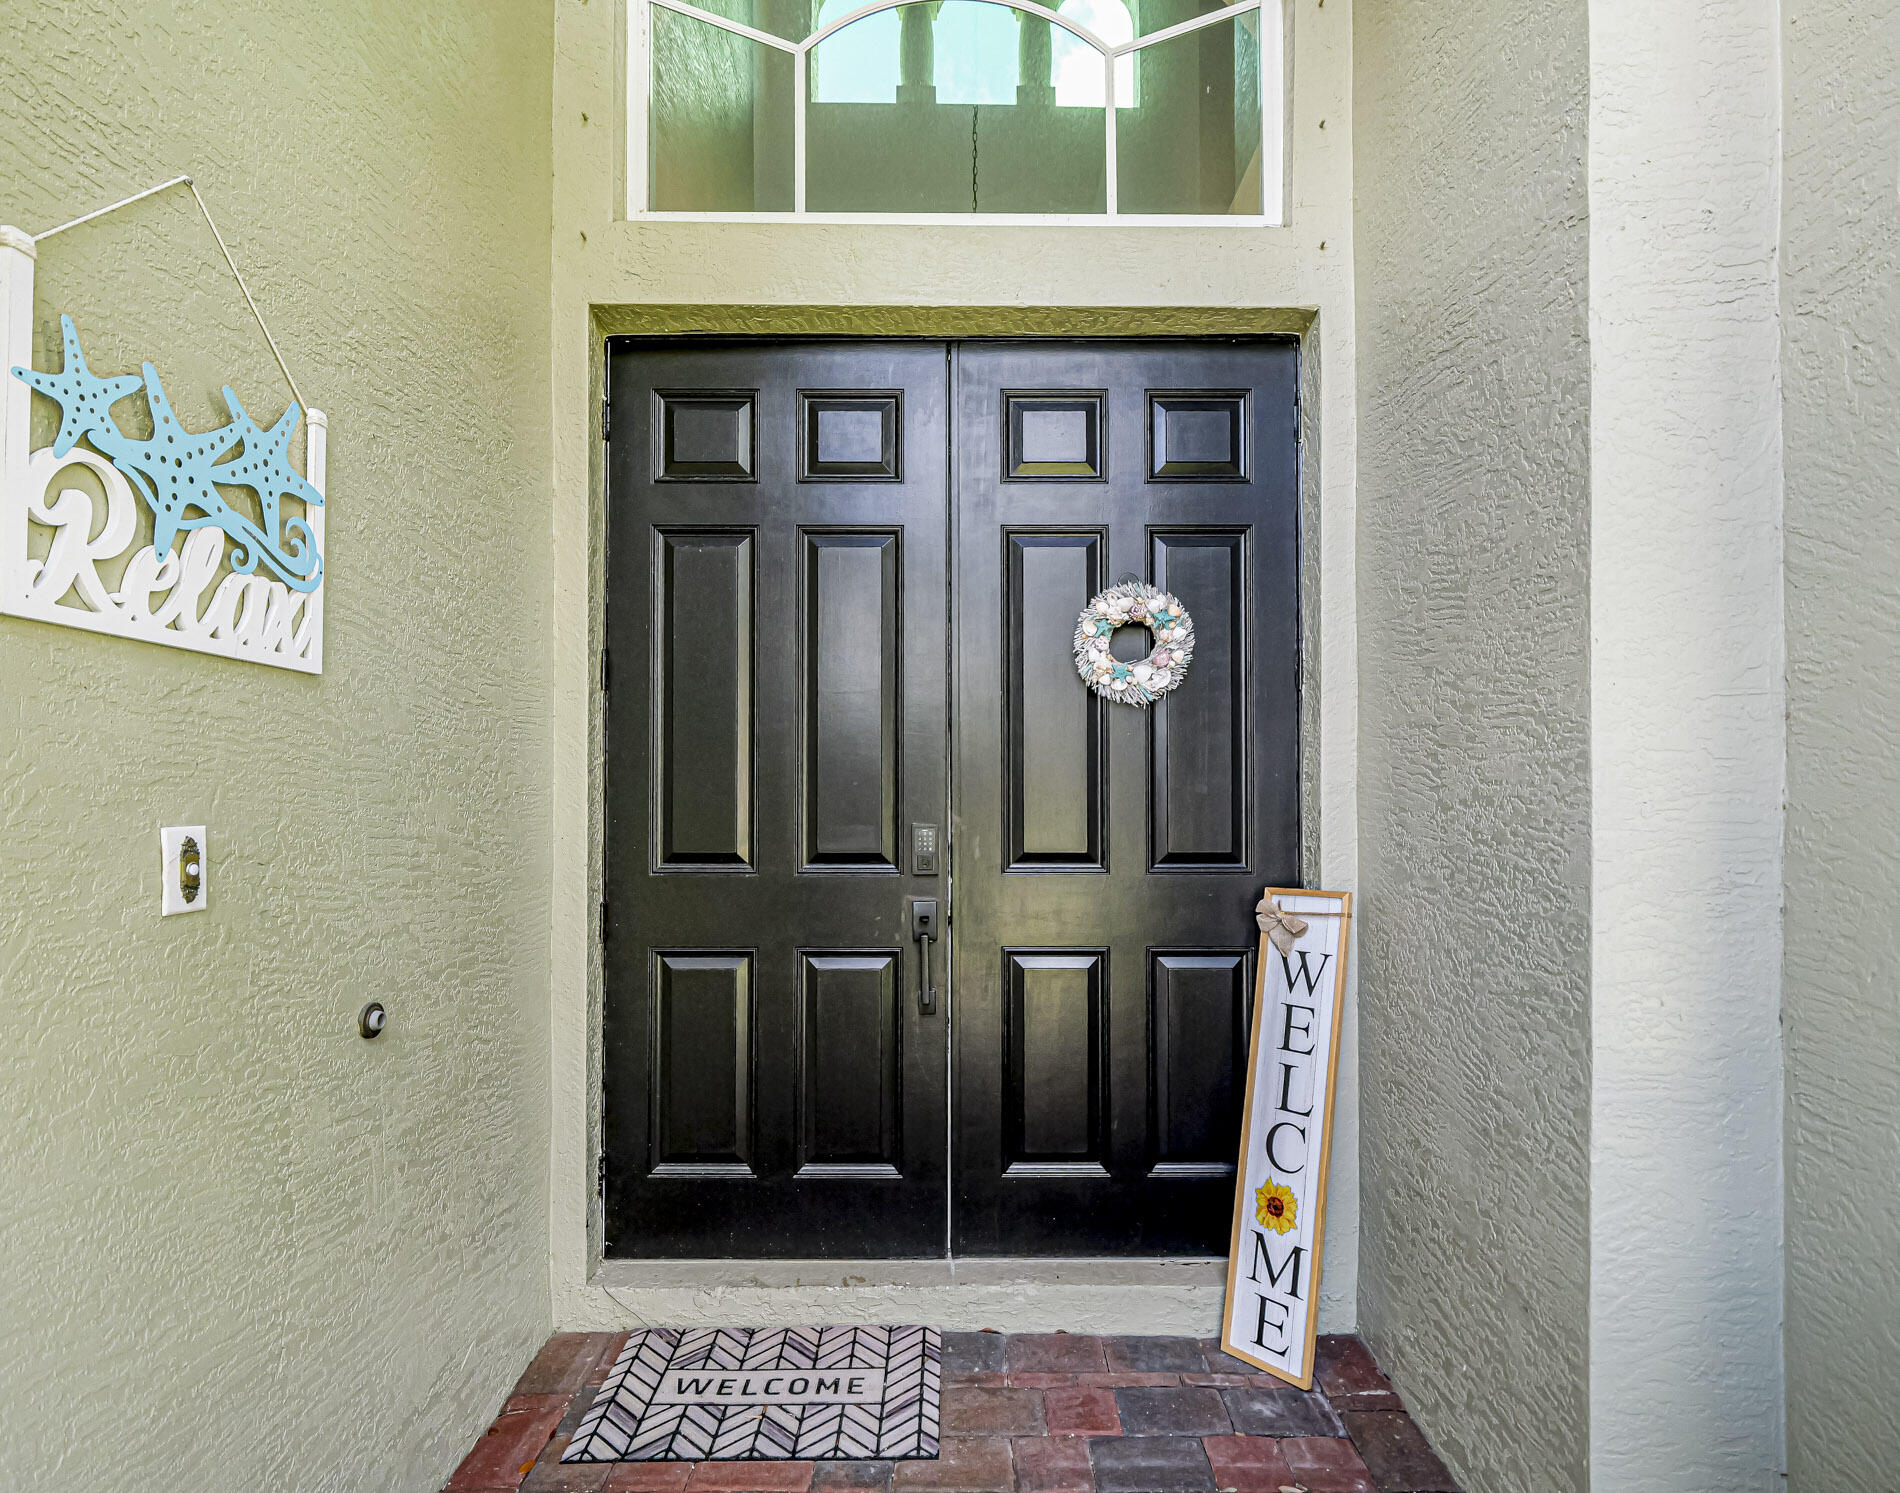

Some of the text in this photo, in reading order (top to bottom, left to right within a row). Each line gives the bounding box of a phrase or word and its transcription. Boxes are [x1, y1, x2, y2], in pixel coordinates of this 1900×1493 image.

[27, 447, 313, 658] Relax
[1247, 950, 1333, 1357] WELCME
[677, 1377, 865, 1396] WELCOME
